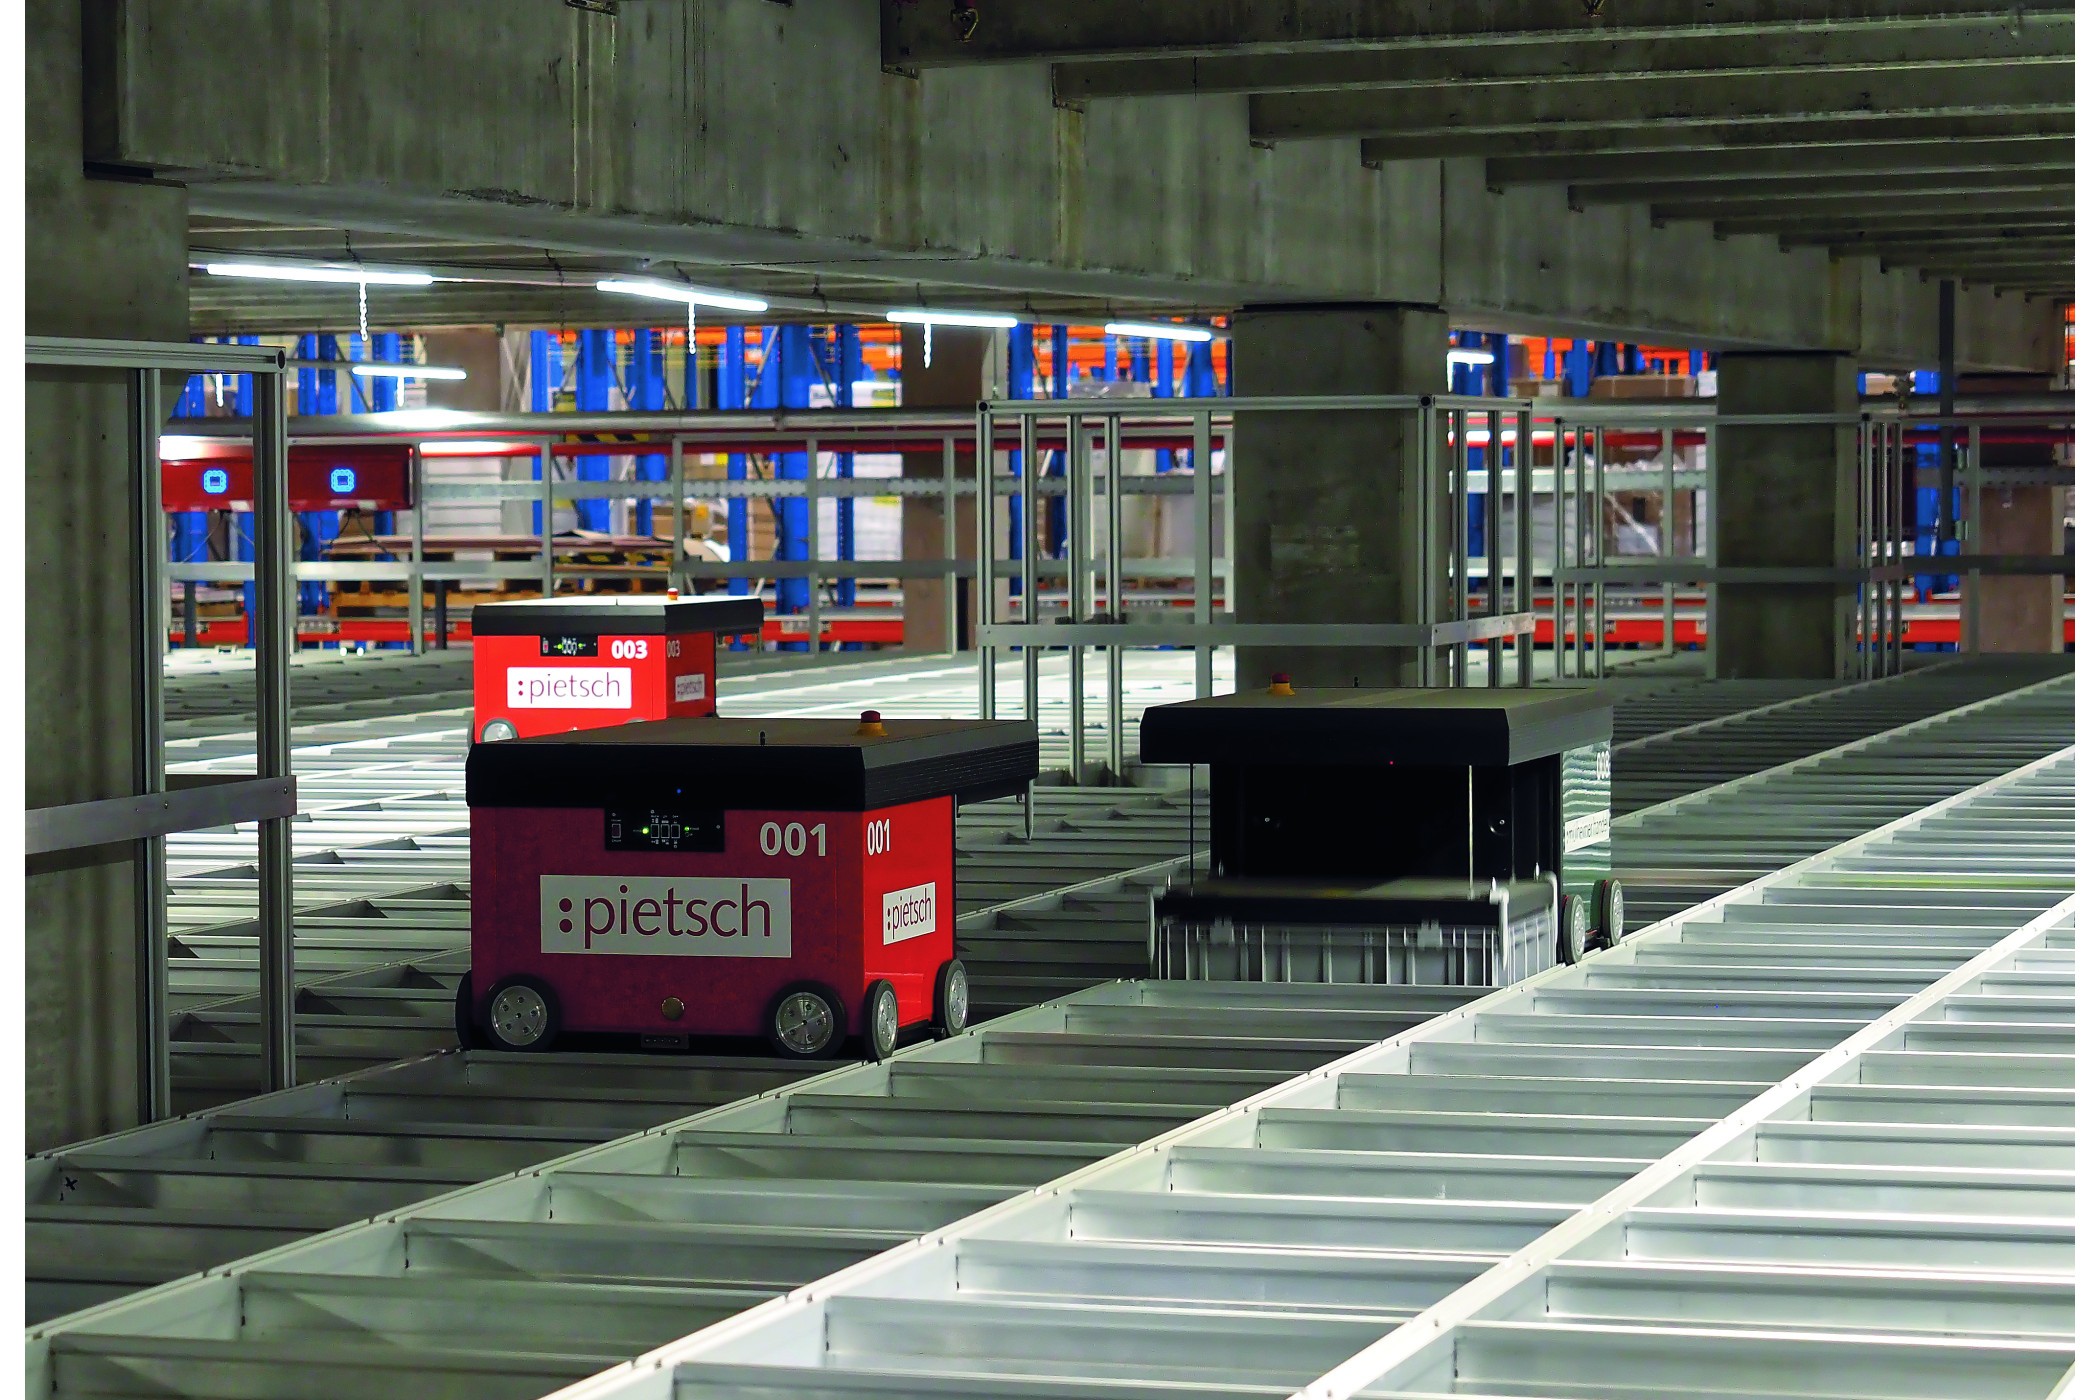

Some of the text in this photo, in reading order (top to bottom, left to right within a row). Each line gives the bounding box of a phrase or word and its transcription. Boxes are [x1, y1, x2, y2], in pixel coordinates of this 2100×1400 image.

[611, 640, 648, 659] 003
[667, 640, 680, 658] 003
[518, 672, 620, 704] :pietsch
[760, 822, 826, 857] 001
[867, 818, 890, 856] 001
[558, 883, 771, 949] :pietsch
[887, 887, 932, 939] :pietsch
